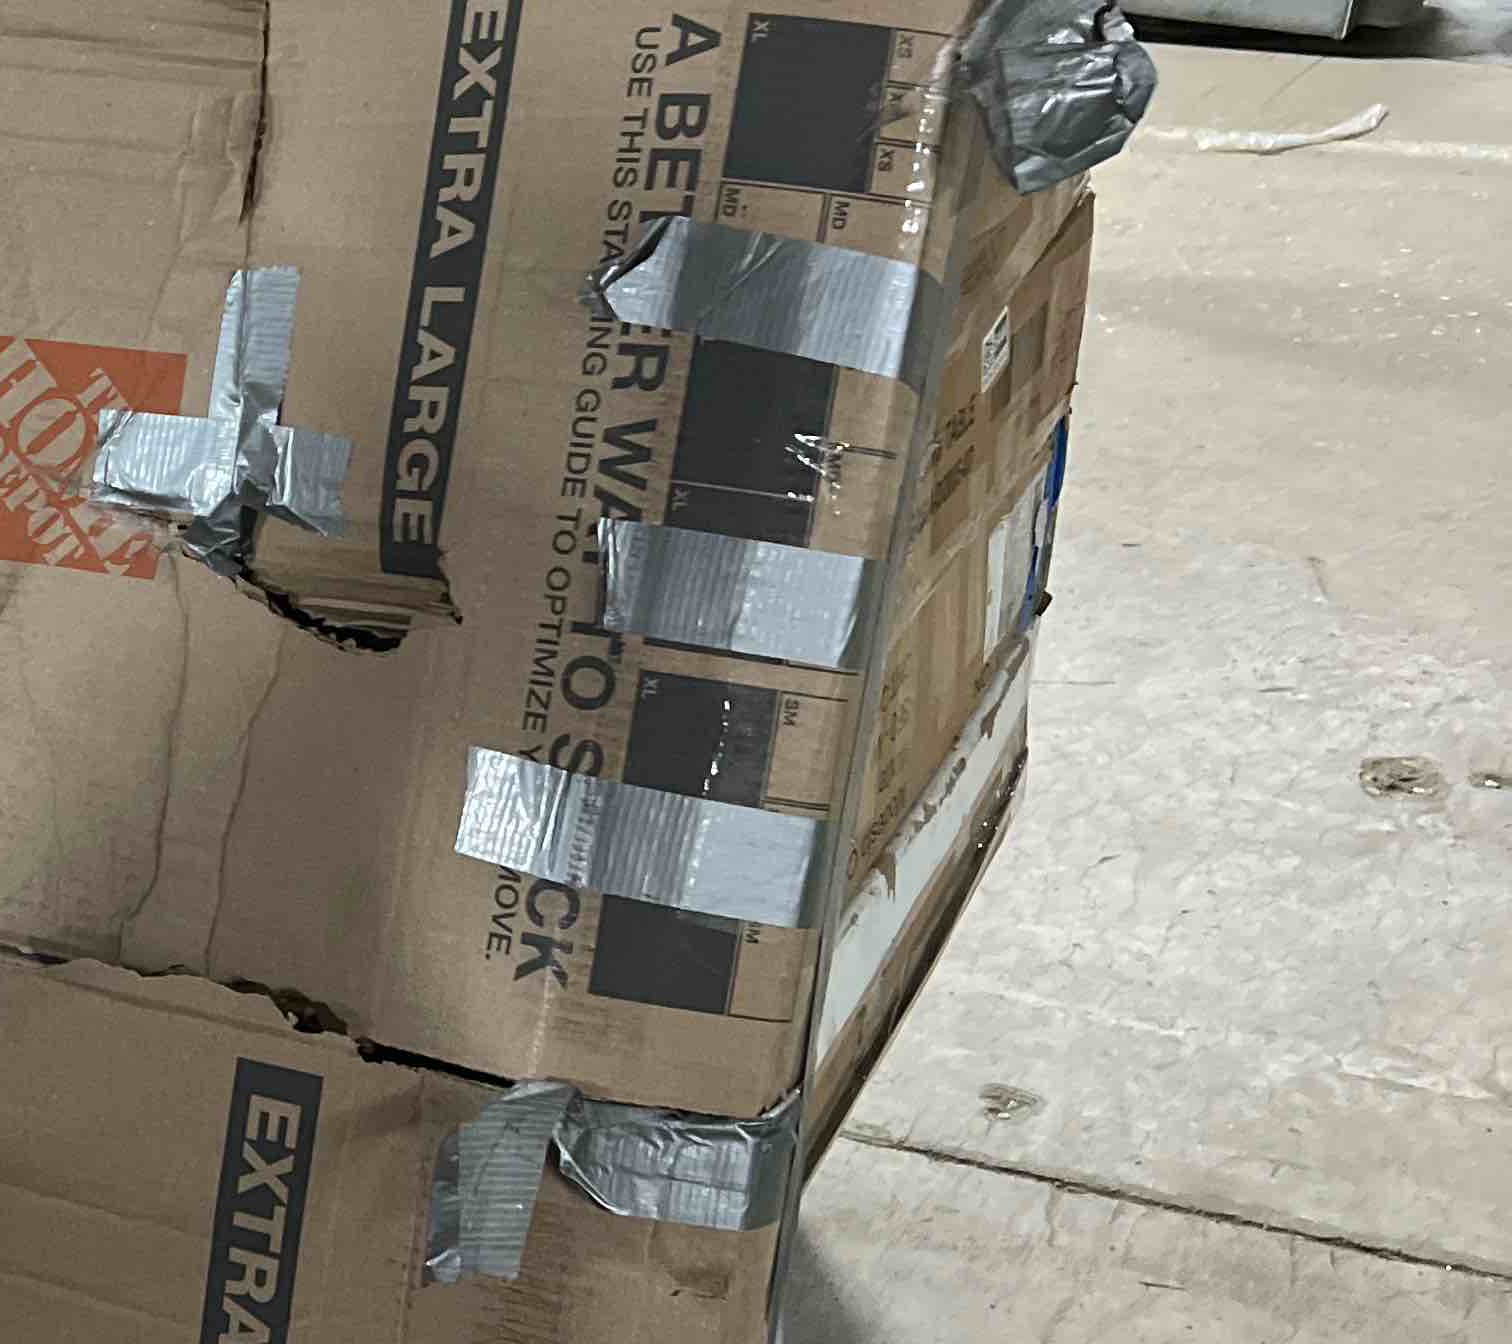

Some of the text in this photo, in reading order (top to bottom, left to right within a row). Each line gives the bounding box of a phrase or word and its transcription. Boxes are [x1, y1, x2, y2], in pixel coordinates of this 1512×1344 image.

[626, 26, 662, 98] USE
[665, 14, 721, 66] A
[612, 107, 649, 189] THIS
[388, 285, 467, 548] LARGE
[561, 388, 601, 498] GUIDE
[551, 507, 582, 555] TO
[520, 566, 572, 734] OPTIMIZE
